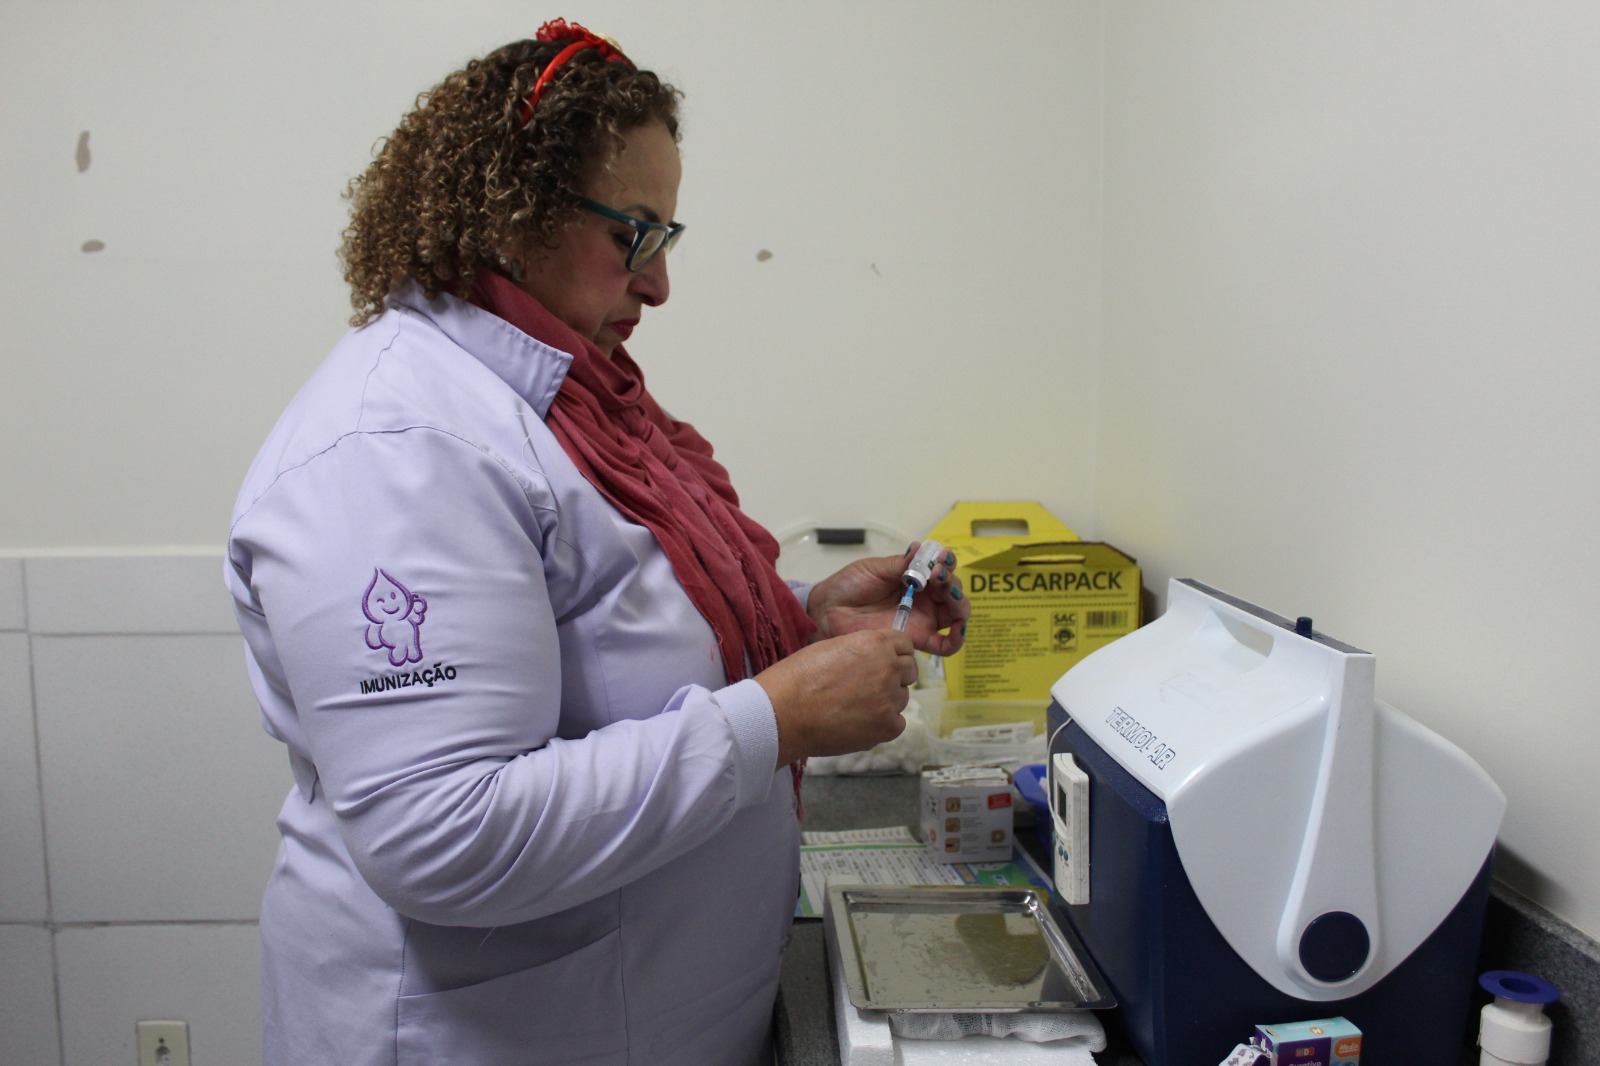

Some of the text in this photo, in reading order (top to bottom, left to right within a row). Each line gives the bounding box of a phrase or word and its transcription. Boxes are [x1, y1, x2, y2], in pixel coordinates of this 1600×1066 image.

[970, 571, 1123, 593] DESCARPACK
[1054, 613, 1076, 624] SAC
[360, 662, 457, 694] IMUNIZAÇÃO
[1105, 706, 1176, 771] TERMOLAR
